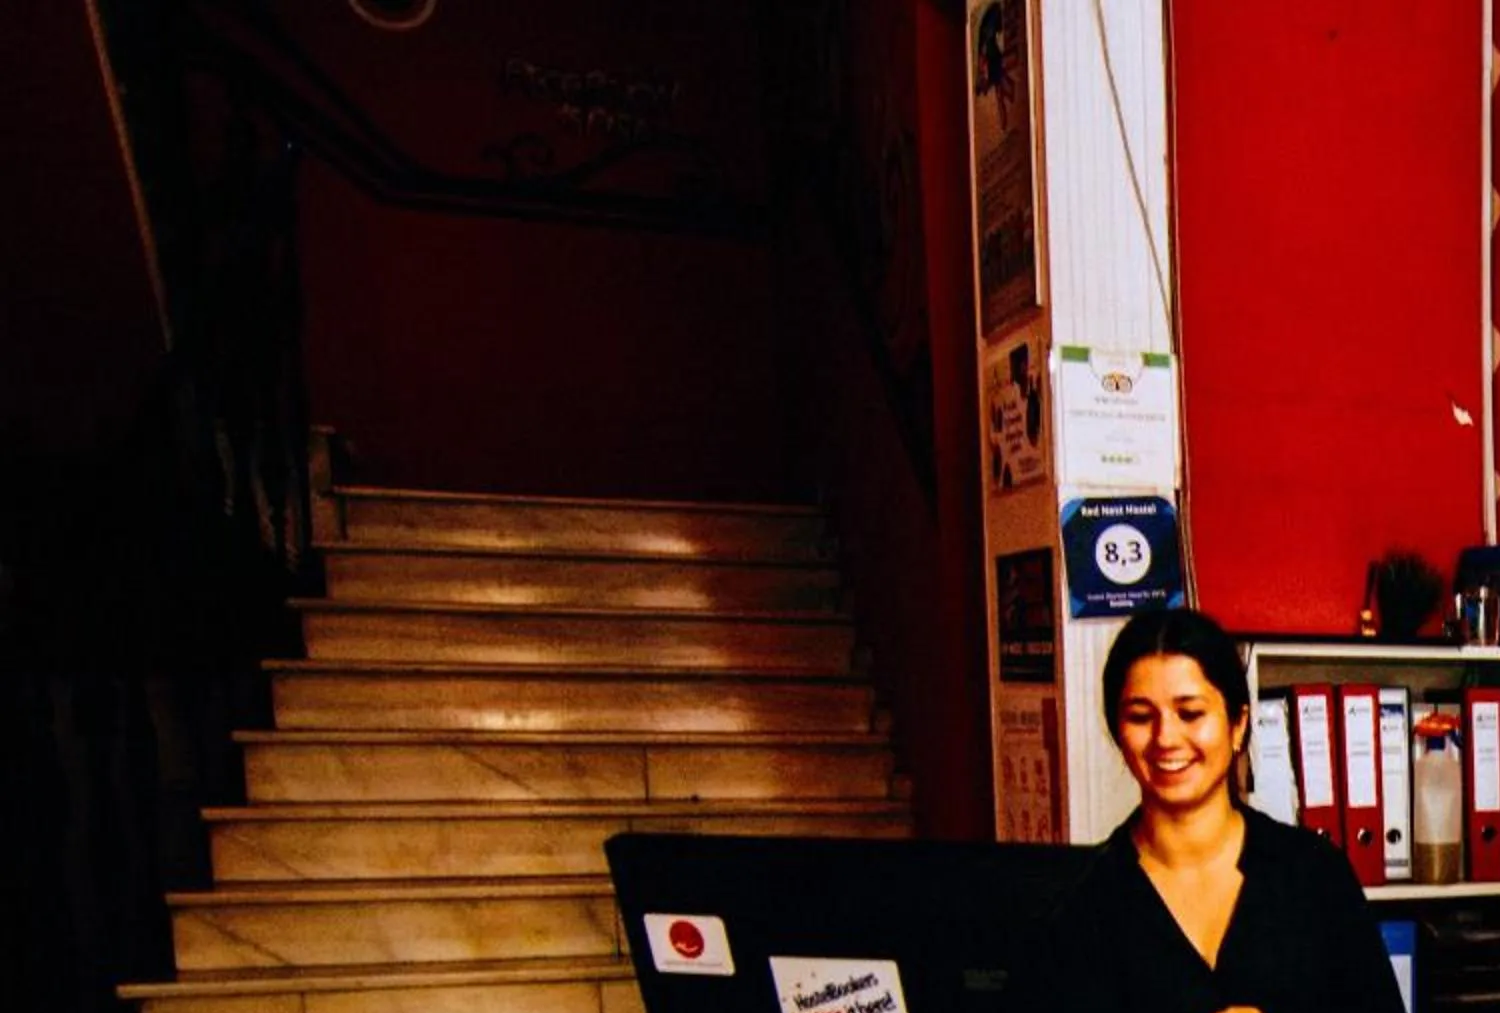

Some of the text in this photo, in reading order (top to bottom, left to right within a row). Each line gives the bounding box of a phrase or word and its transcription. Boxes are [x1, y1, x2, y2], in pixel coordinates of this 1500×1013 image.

[1081, 505, 1100, 517] Red
[1101, 505, 1124, 516] Nest
[1104, 539, 1142, 566] 8,3
